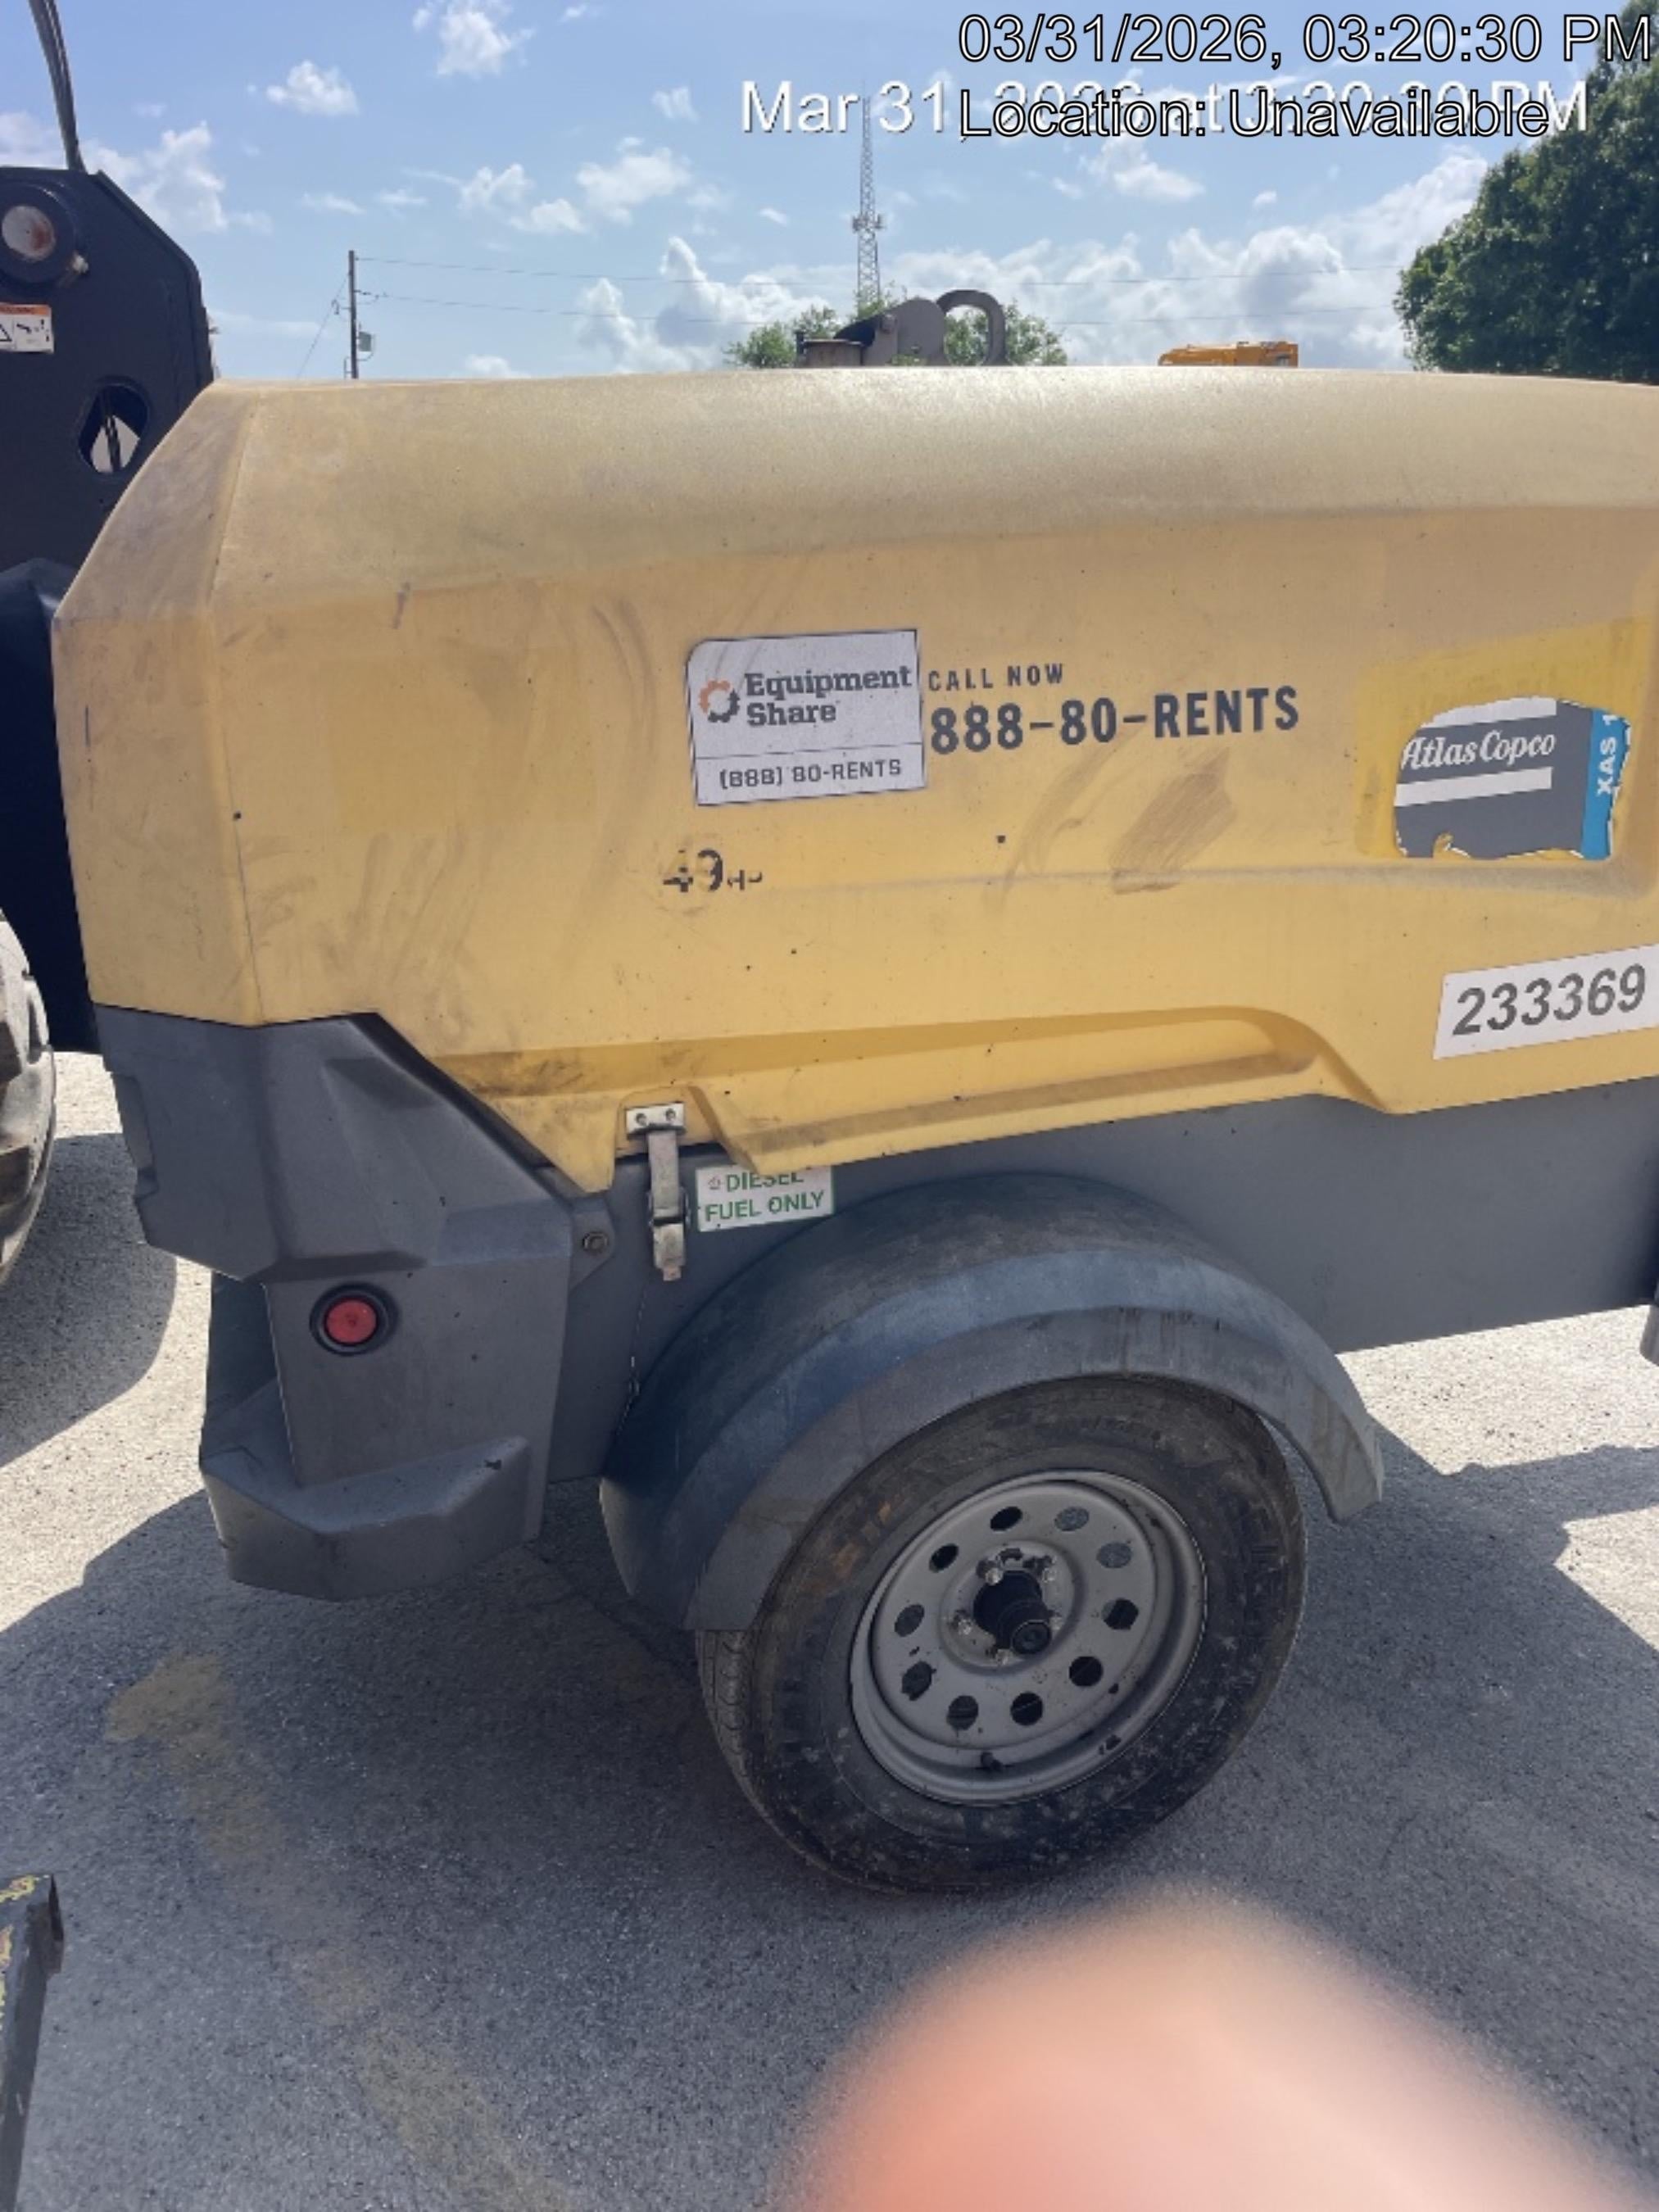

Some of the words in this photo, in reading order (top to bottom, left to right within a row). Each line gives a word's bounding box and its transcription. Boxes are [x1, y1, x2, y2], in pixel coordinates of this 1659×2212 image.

[744, 665, 912, 700] Equipment
[928, 668, 993, 691] CALL
[1007, 663, 1063, 687] NOW
[746, 701, 836, 727] Share
[930, 685, 1299, 755] 888-80-RENTS
[1400, 737, 1478, 770] Atlas
[1480, 729, 1556, 766] Copco
[720, 765, 782, 790] (888)
[792, 759, 901, 783] 80-RENTS
[1597, 737, 1616, 796] XAS
[1453, 963, 1646, 1035] 233369
[726, 1172, 805, 1192] DIESEL
[705, 1199, 762, 1222] FUEL
[768, 1190, 824, 1214] ONLY
